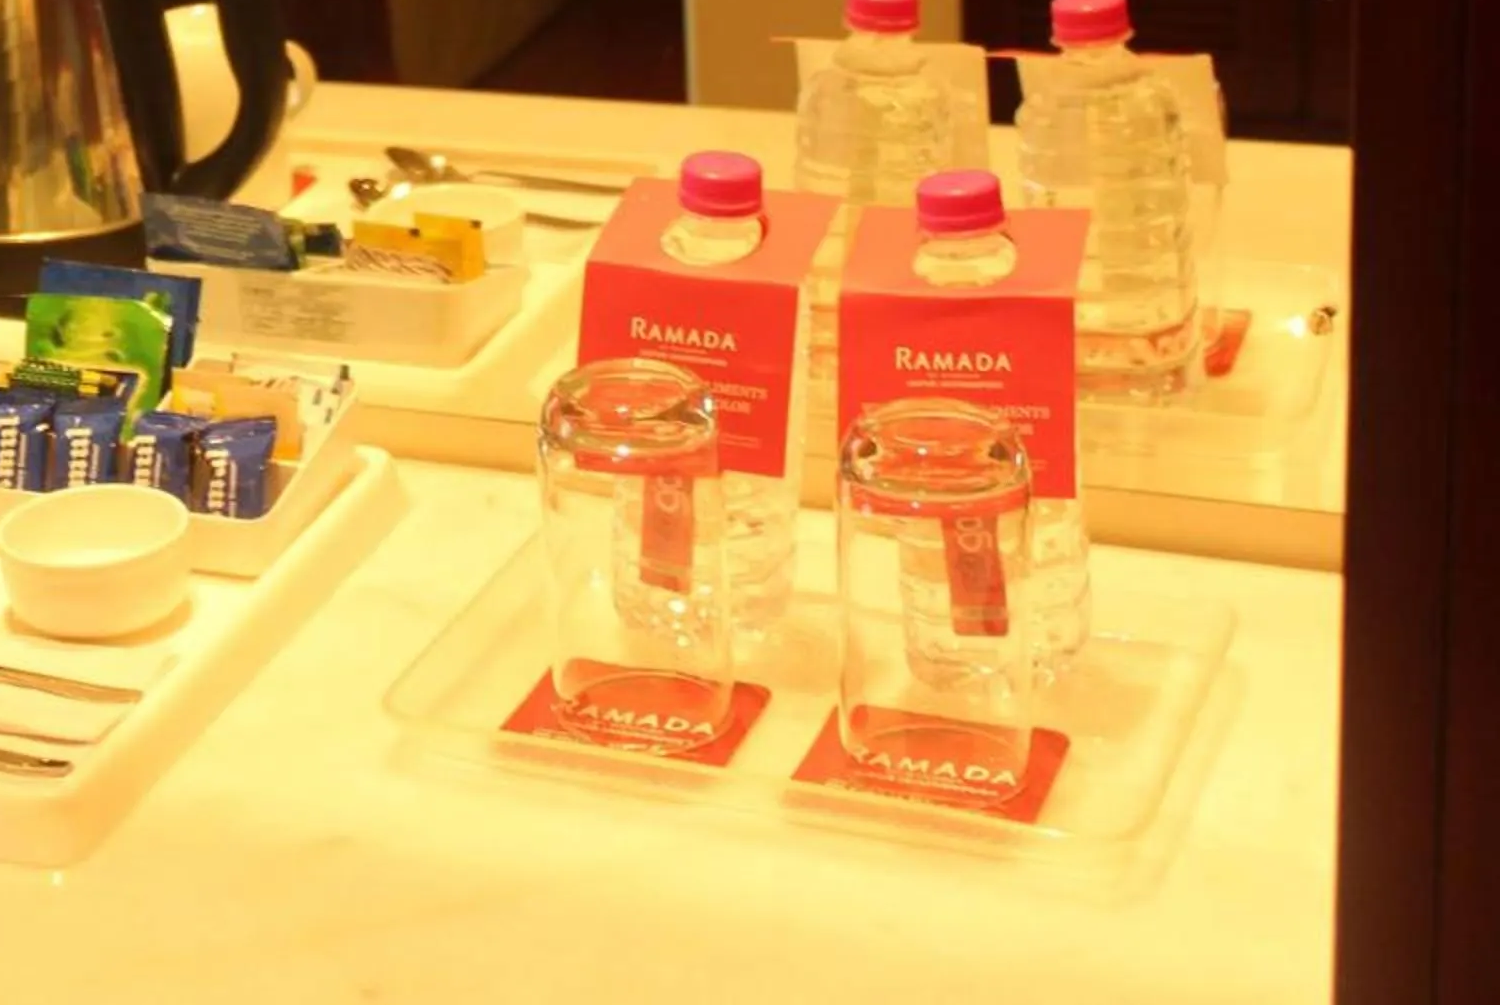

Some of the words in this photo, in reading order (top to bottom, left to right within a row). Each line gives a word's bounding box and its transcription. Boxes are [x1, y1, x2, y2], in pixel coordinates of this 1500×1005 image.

[630, 315, 738, 353] RAMADA
[895, 346, 1012, 372] RAMADA
[64, 427, 92, 489] mul
[850, 745, 1017, 788] RAMADA
